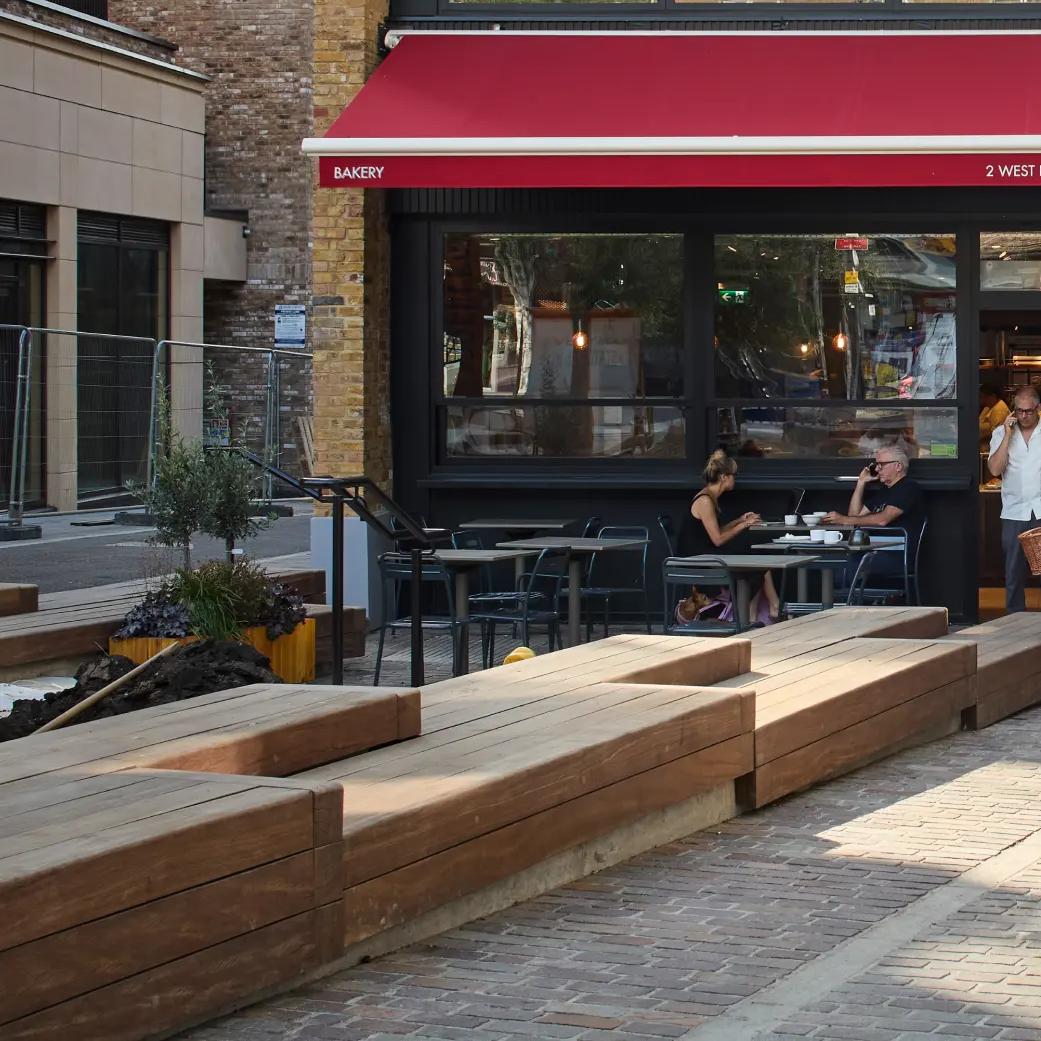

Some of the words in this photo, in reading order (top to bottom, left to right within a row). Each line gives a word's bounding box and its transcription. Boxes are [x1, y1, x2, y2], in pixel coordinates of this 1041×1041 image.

[334, 166, 385, 179] BAKERY
[985, 164, 995, 177] 2
[998, 164, 1036, 177] WEST
